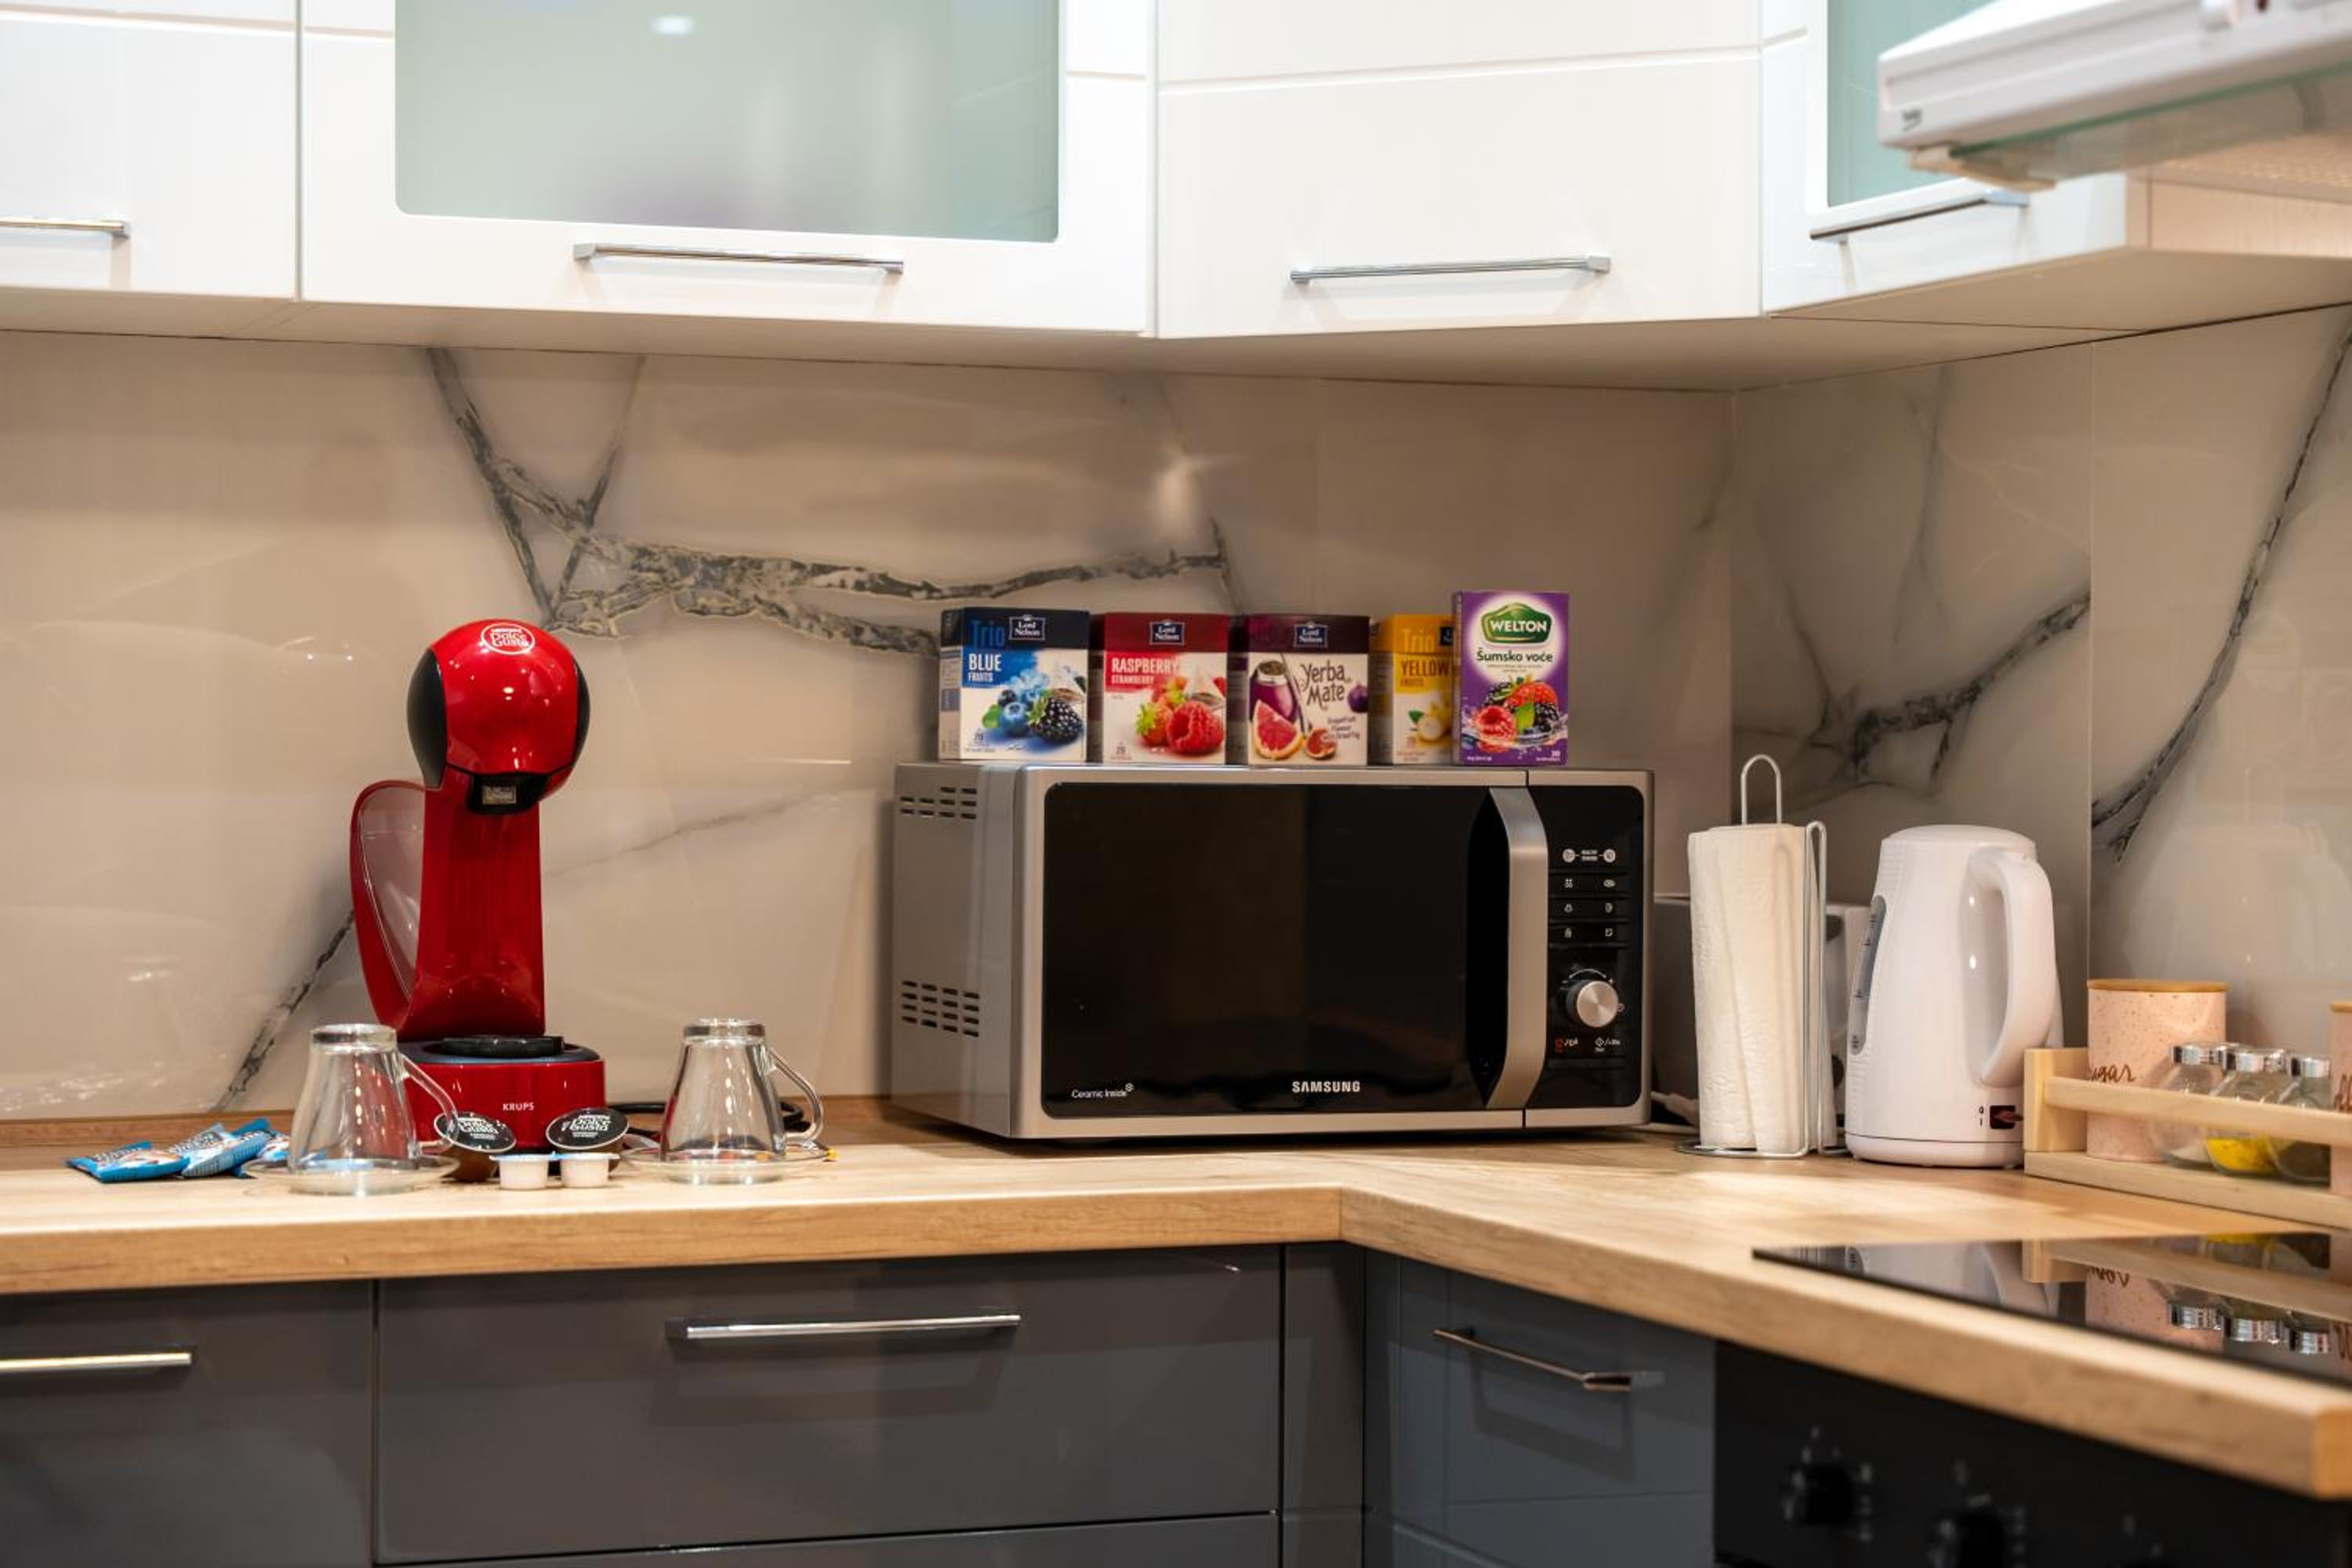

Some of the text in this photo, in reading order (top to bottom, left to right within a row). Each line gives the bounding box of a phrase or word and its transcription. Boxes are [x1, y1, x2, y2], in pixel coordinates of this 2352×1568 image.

[971, 619, 1004, 648] Trio
[1490, 620, 1548, 633] WELTON
[968, 652, 1002, 672] BLUE
[1477, 647, 1554, 662] Šumsko voće
[1111, 657, 1180, 673] RASPBERRY
[1400, 659, 1450, 677] YELLOW
[1301, 659, 1352, 691] Yerba
[1306, 681, 1345, 710] Mate
[1291, 1081, 1360, 1093] SAMSUNG
[503, 1102, 535, 1112] KRUPS
